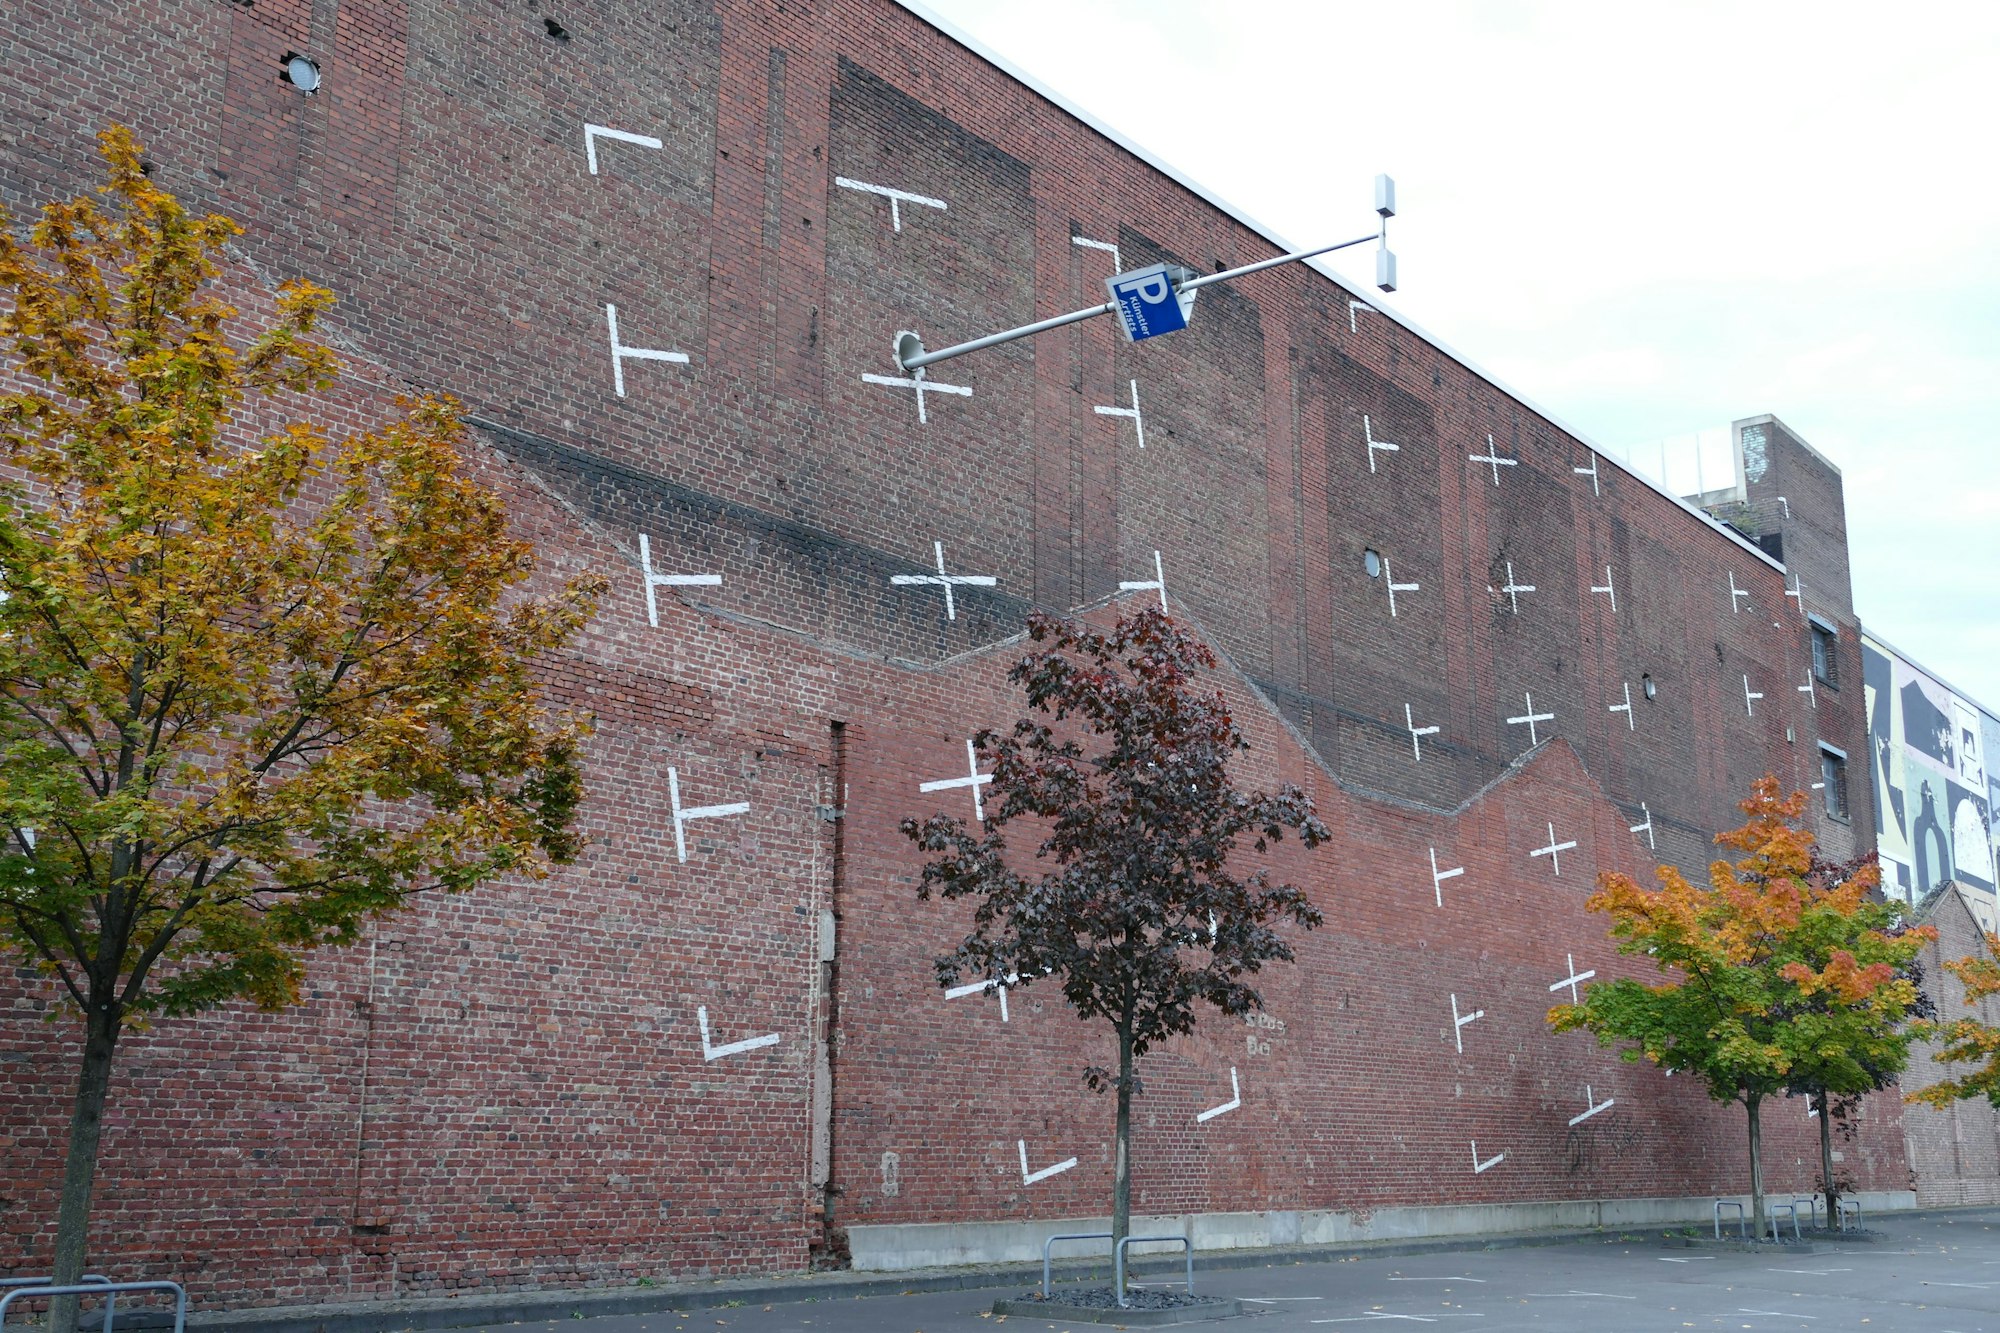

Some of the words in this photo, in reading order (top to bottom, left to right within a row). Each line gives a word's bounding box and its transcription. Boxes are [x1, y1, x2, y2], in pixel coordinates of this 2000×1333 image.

[1119, 273, 1168, 304] P
[1120, 299, 1137, 332] Artists
[1130, 296, 1150, 336] Künstler
